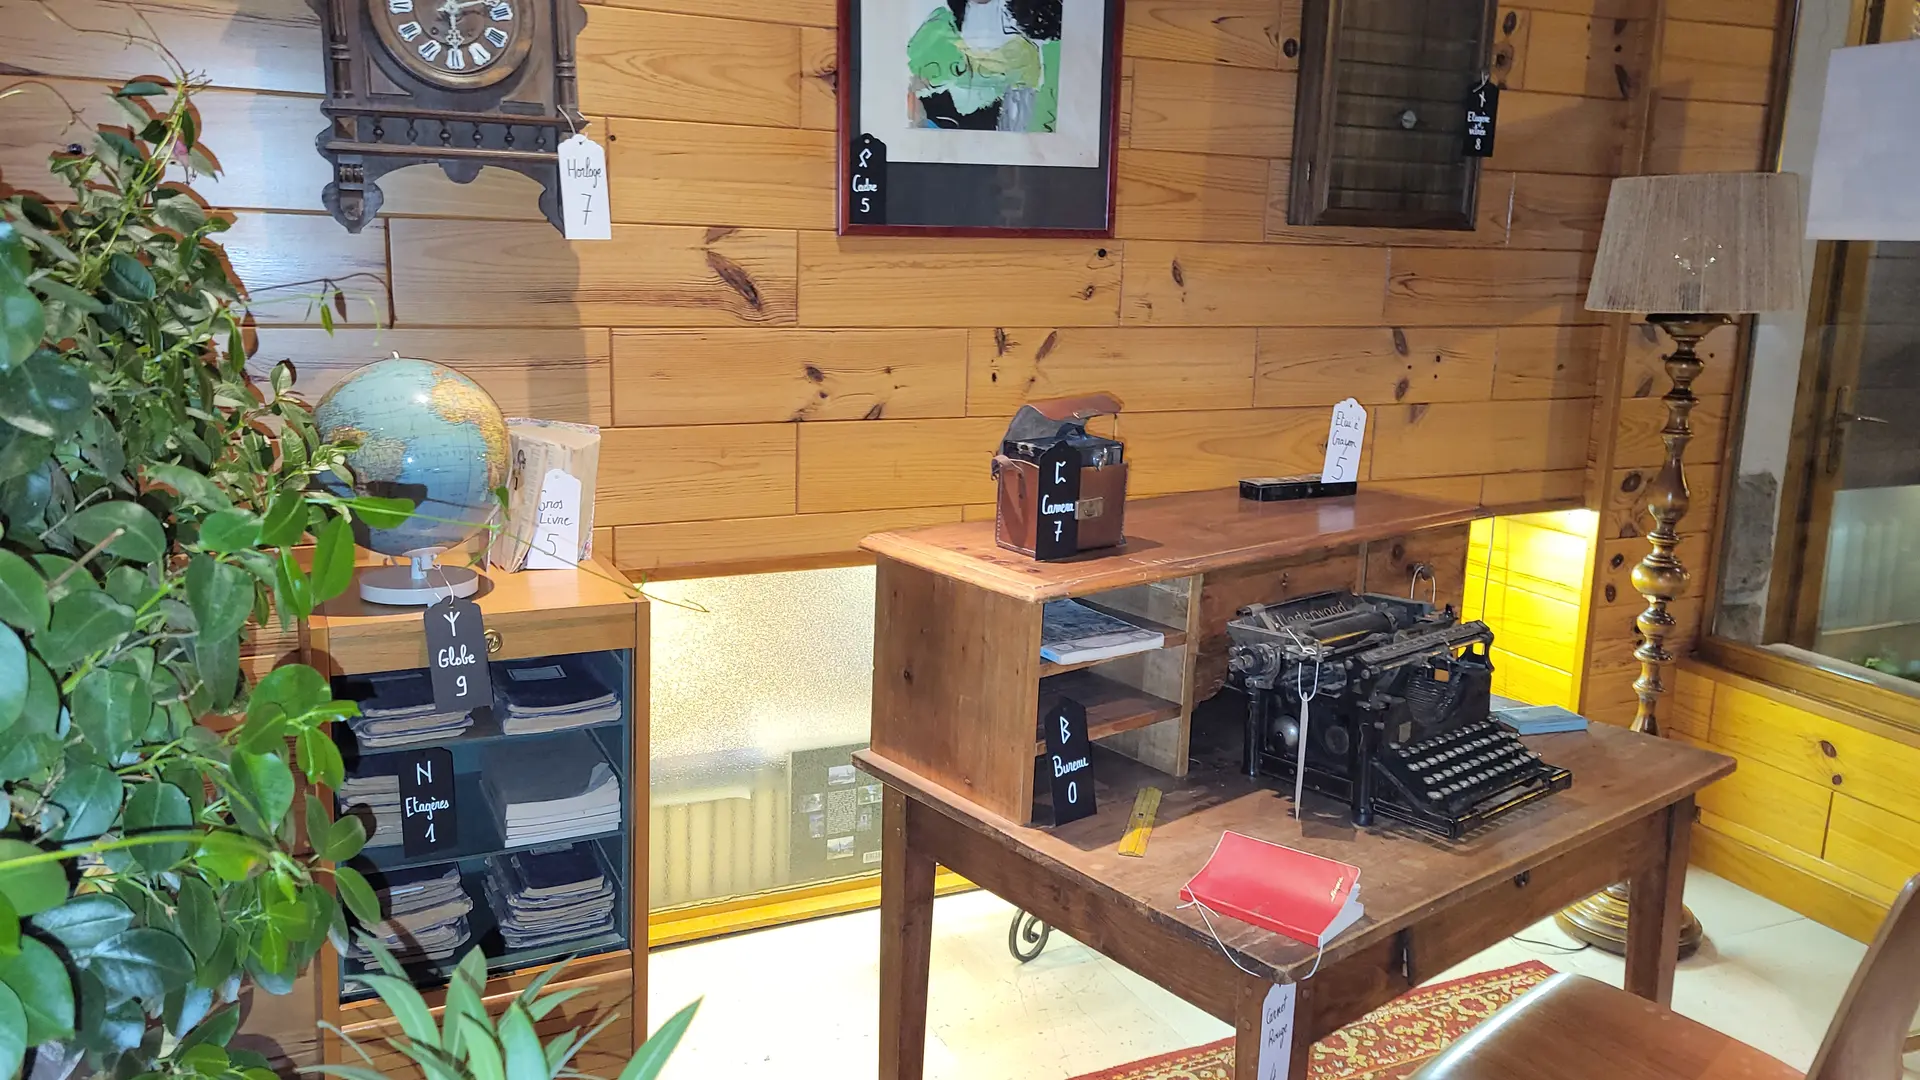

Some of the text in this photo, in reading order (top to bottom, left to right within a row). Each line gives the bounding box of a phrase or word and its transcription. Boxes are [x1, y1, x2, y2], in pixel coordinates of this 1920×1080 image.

[1474, 138, 1482, 151] 8
[567, 157, 601, 188] Horloge
[581, 193, 593, 225] 7
[860, 197, 870, 213] 5
[1331, 456, 1348, 481] 5
[540, 512, 573, 526] Livre
[1053, 520, 1063, 542] 7
[544, 533, 559, 557] 5
[1276, 600, 1348, 627] Underwood
[438, 644, 476, 668] Globe
[456, 675, 468, 697] 9
[1052, 755, 1089, 778] Bureau
[405, 796, 450, 821] Etagères
[424, 823, 437, 843] 1
